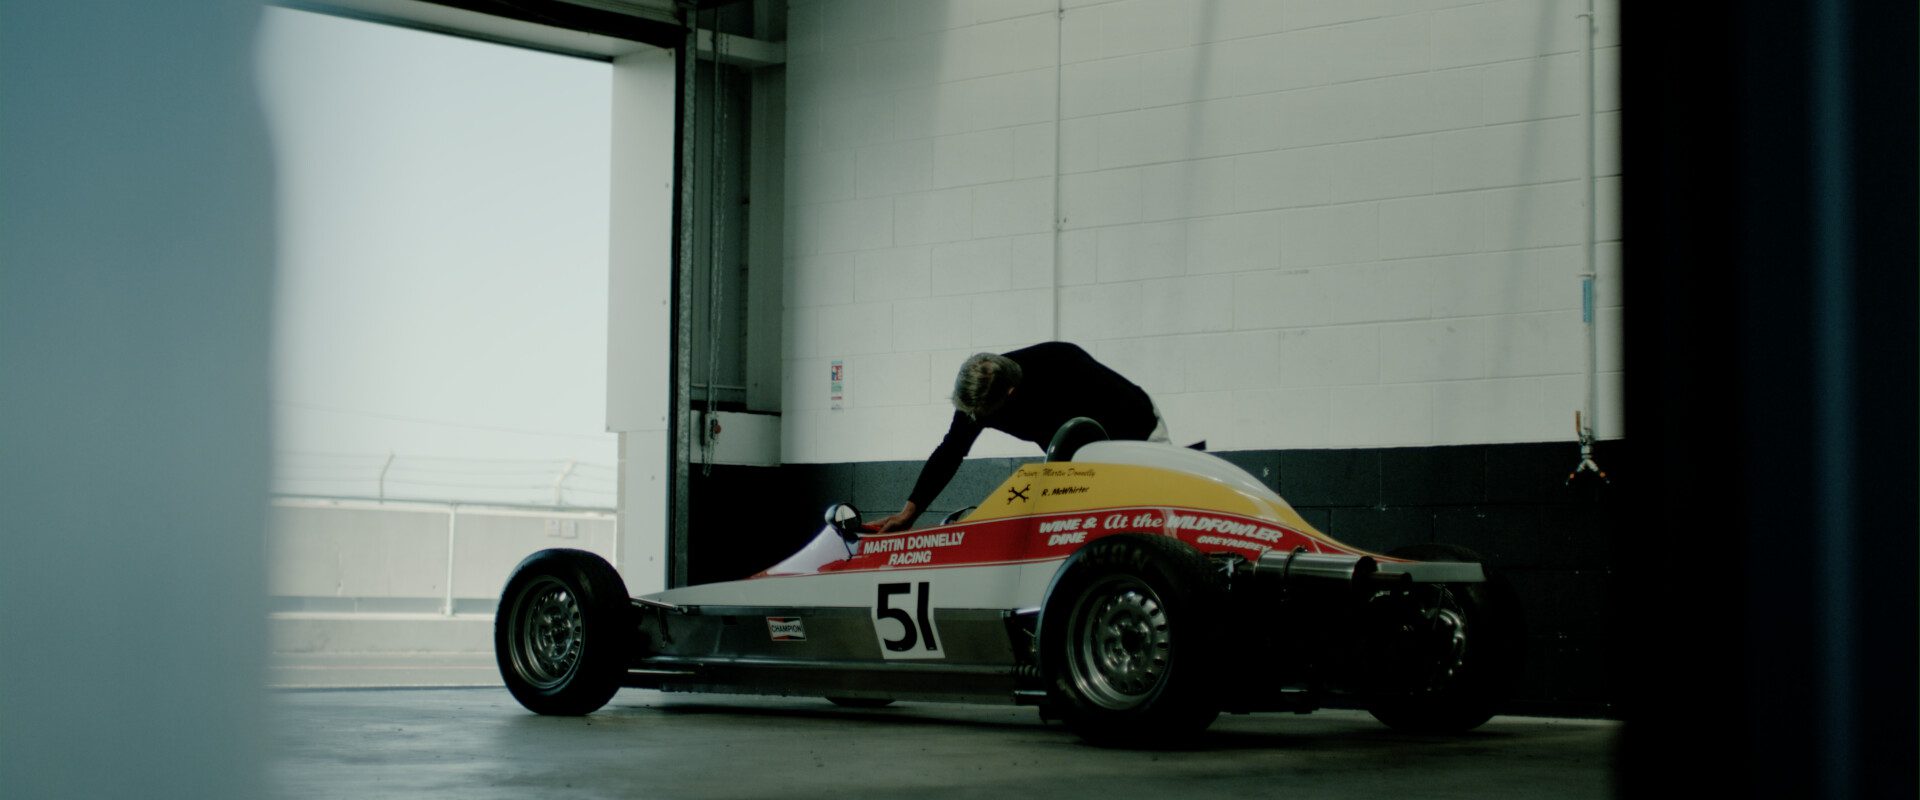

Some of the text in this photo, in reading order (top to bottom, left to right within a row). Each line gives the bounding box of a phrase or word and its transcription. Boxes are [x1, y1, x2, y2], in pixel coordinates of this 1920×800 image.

[1039, 517, 1098, 534] WINE &
[1103, 513, 1283, 544] At the WILDFOWLER
[863, 532, 965, 554] MARTIN DONNELLY
[1047, 531, 1088, 546] DINE
[888, 550, 932, 565] RACING
[877, 582, 938, 652] 51
[771, 623, 802, 633] CHAMPION
